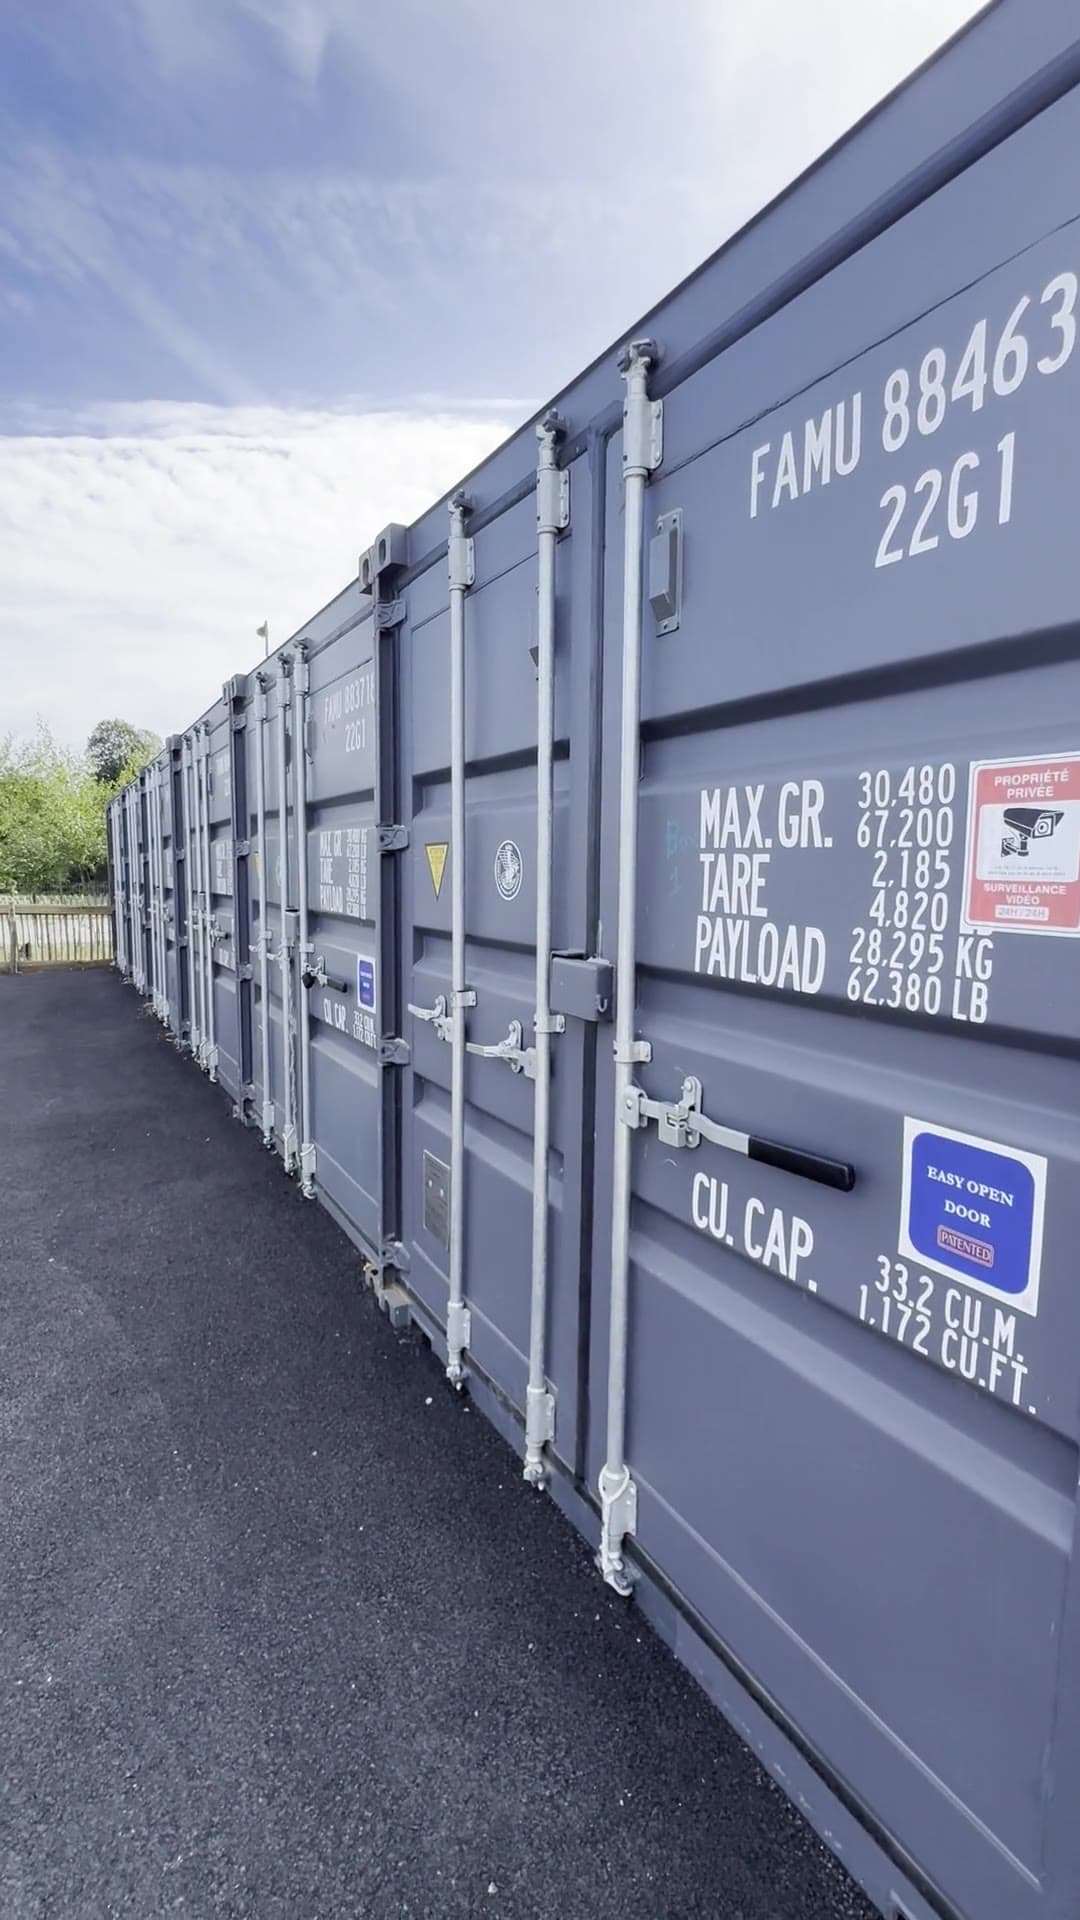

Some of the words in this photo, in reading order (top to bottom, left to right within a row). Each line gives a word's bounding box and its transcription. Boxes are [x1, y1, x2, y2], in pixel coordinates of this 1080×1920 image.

[750, 391, 862, 519] FAMU
[881, 272, 1078, 453] 88463
[874, 432, 1016, 568] 22G1
[858, 763, 955, 809] 30,480
[994, 769, 1070, 787] PROPRIÉTÉ
[1007, 784, 1055, 799] PRIVÉE
[857, 807, 953, 848] 67,200
[700, 853, 770, 917] TARE
[872, 849, 950, 890] 2,185
[983, 882, 1067, 895] SURVEILLANCE
[1006, 894, 1040, 905] VIDÉO
[869, 891, 947, 932] 4,820
[695, 915, 826, 994] PAYLOAD
[849, 928, 944, 973] 28,295
[955, 936, 994, 980] KG
[846, 968, 942, 1015] 62,380
[952, 979, 988, 1023] LB
[927, 1166, 964, 1190] EASY
[966, 1180, 1014, 1207] OPEN
[944, 1199, 991, 1228] DOOR
[941, 1231, 991, 1261] PATENTED
[875, 1255, 934, 1316] 33.2
[860, 1285, 929, 1355] 1,172
